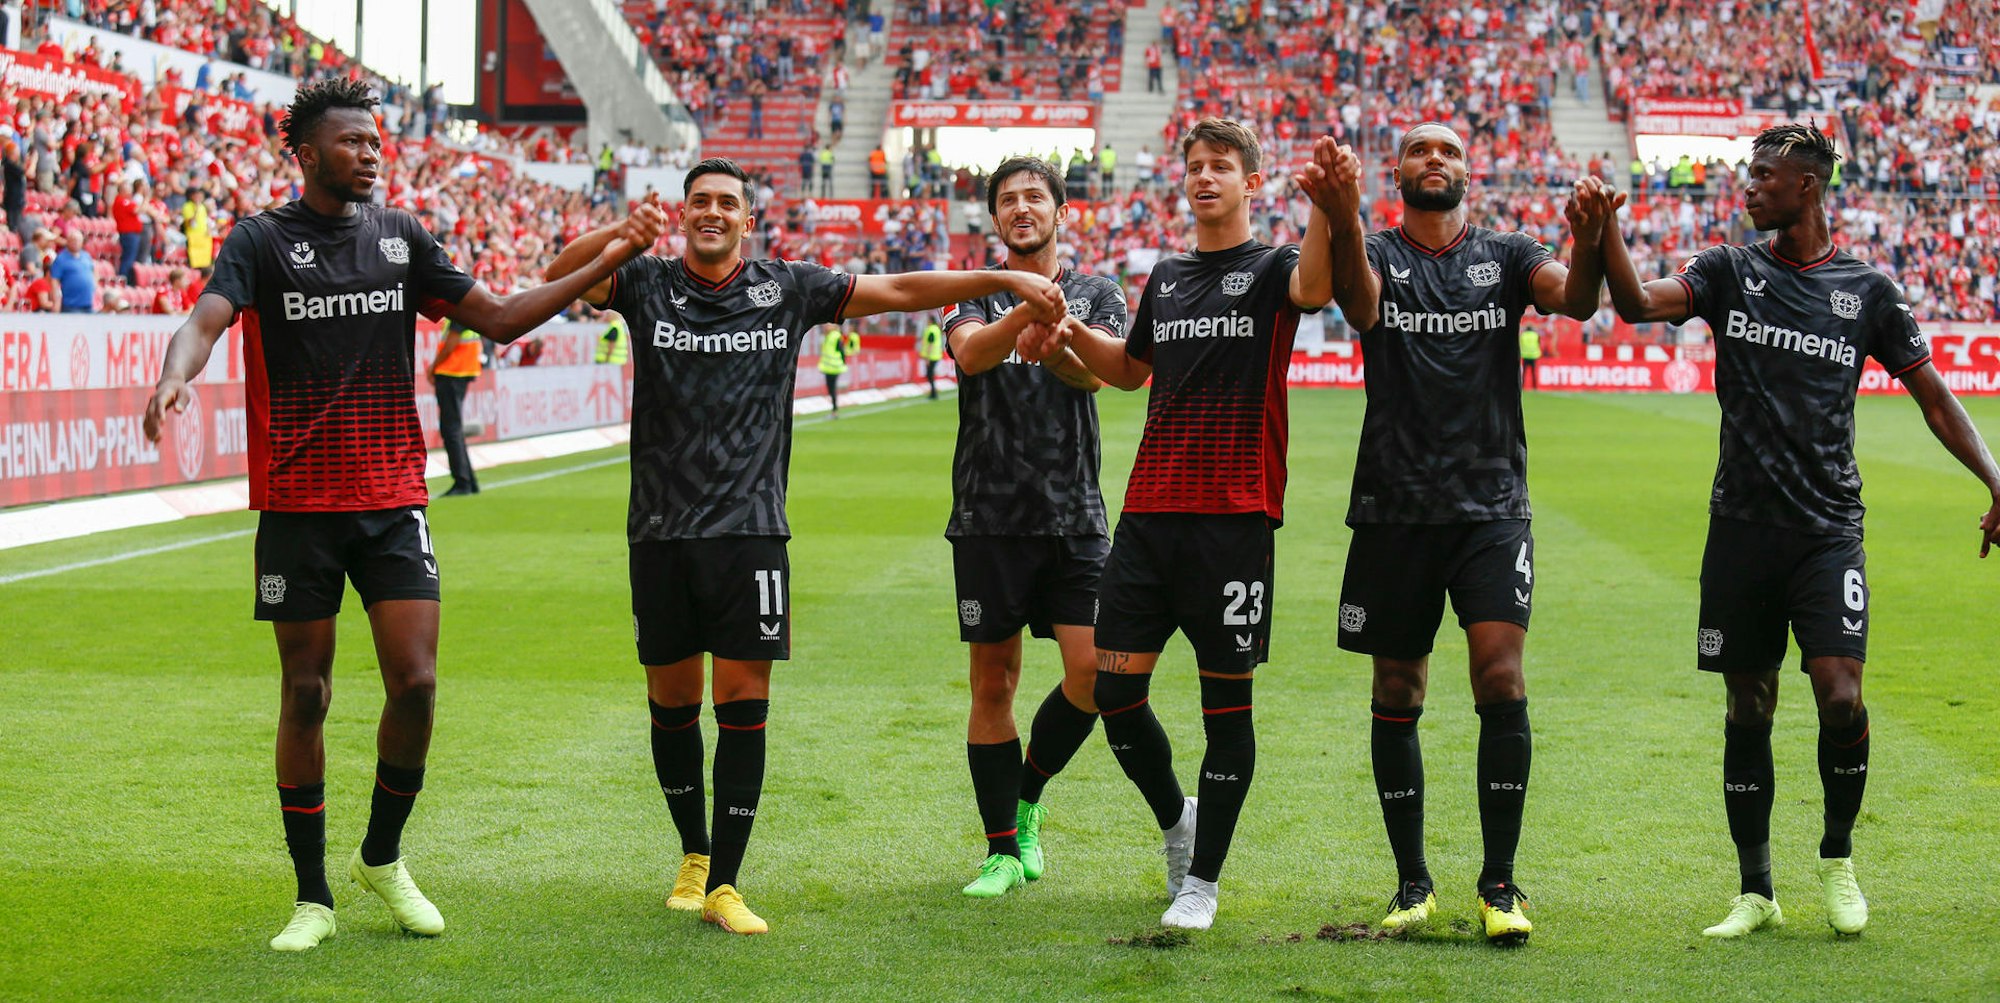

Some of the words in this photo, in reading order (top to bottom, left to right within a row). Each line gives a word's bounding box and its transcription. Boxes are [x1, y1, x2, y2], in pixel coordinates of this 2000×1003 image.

[293, 241, 310, 253] 36
[653, 320, 788, 353] Barmenia
[1383, 301, 1507, 333] Barmenia
[1726, 309, 1856, 367] Barmenia
[0, 331, 52, 390] ERA
[107, 331, 172, 386] MEW
[1538, 365, 1651, 387] BITBURGER
[1515, 540, 1532, 584] 4
[755, 570, 783, 615] 11
[1223, 580, 1264, 626] 23
[1843, 568, 1865, 612] 6
